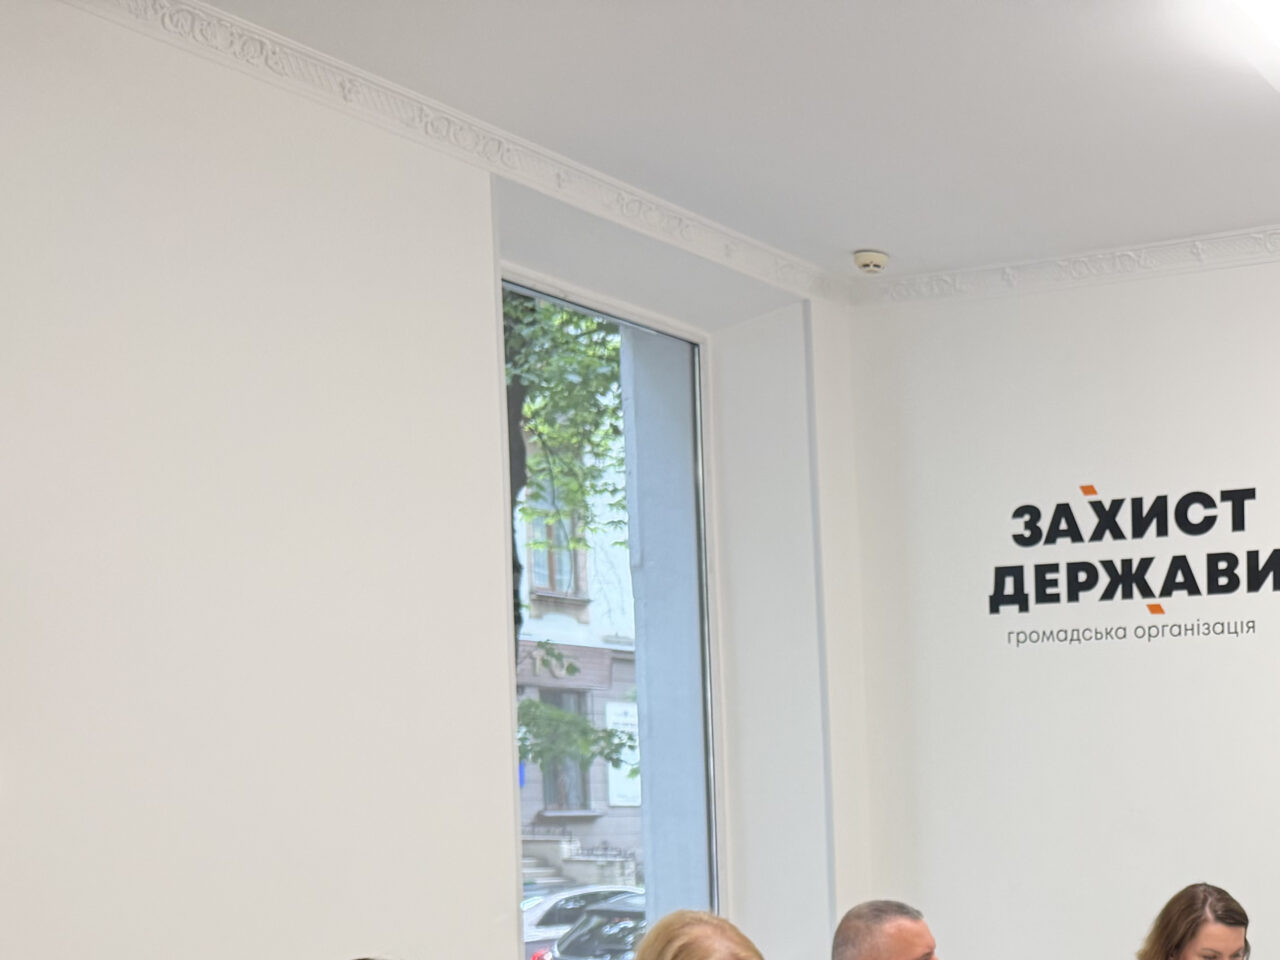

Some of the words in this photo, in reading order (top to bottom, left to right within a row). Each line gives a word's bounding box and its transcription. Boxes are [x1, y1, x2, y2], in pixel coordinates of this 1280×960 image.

[1011, 486, 1256, 547] ЗАХИСТ
[1007, 624, 1127, 647] громадська
[1134, 619, 1257, 643] організація
